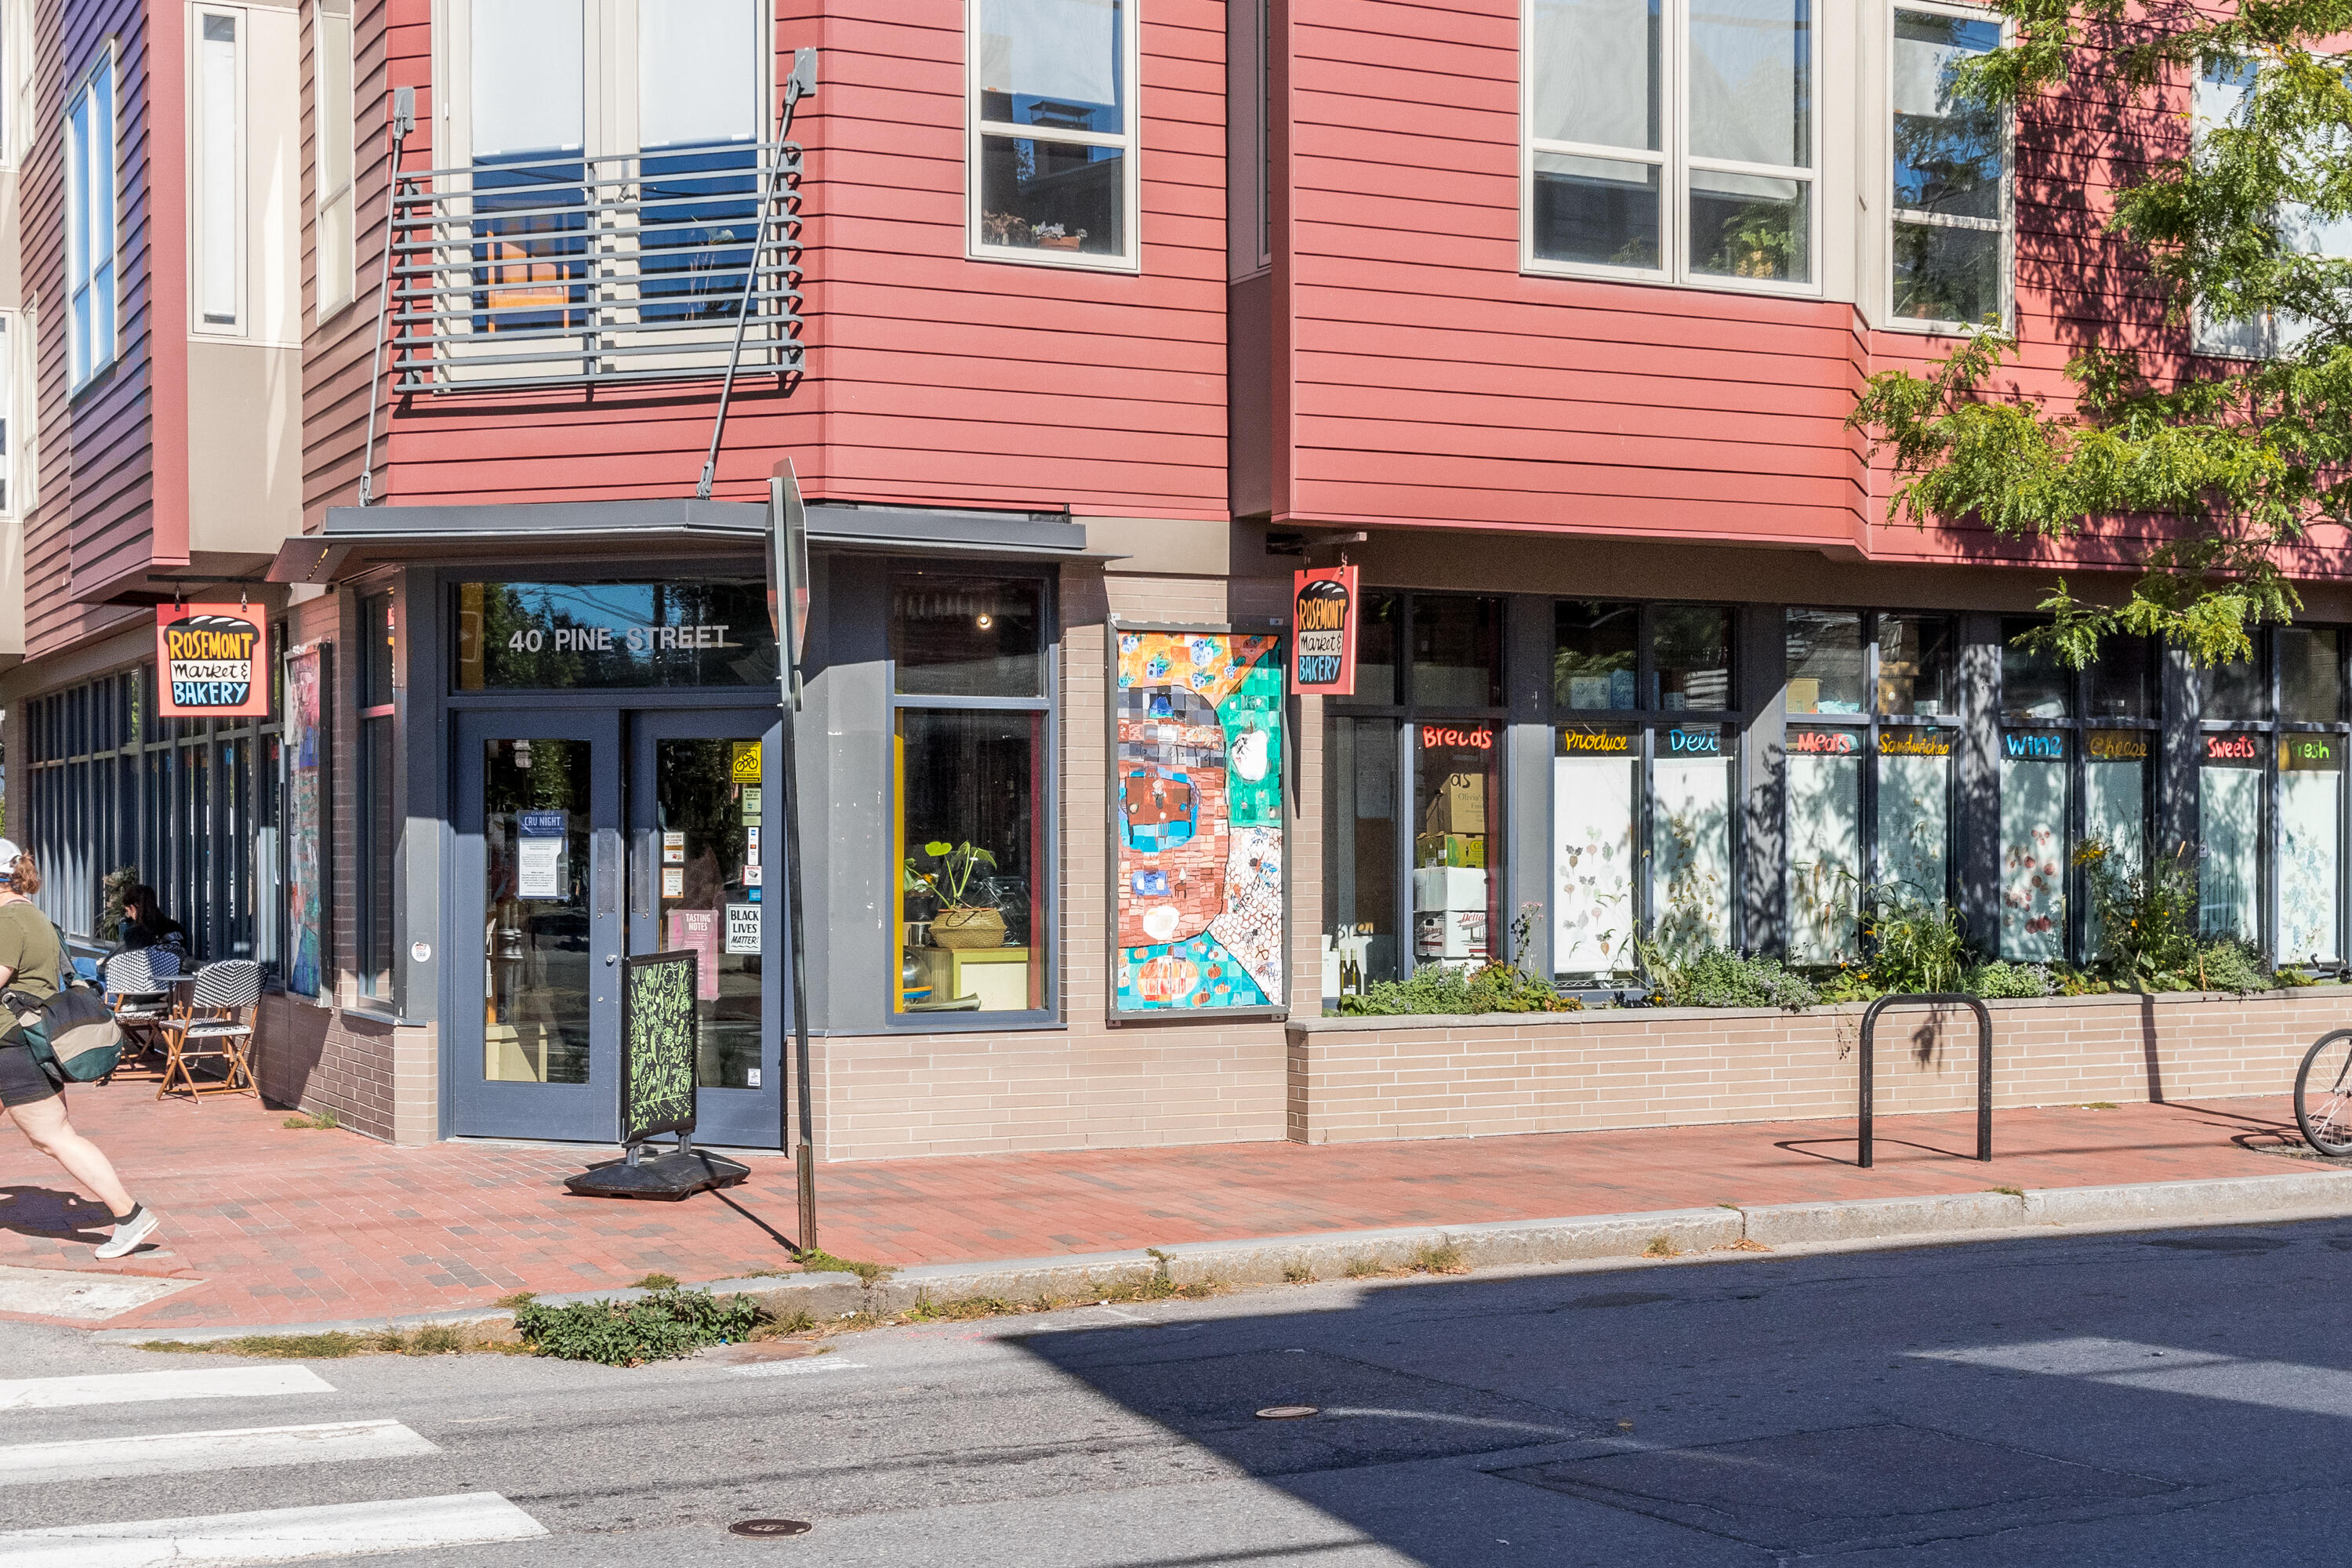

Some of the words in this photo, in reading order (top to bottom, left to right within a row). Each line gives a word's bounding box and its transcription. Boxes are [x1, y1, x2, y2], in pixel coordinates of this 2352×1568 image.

[1298, 597, 1346, 630] ROSEMONT
[169, 630, 253, 659] ROSEMONT
[508, 629, 543, 652] 40
[555, 627, 613, 652] PINE
[627, 625, 729, 652] STREET
[1300, 633, 1336, 652] Market
[172, 662, 239, 680] Market
[241, 662, 249, 680] &
[1299, 655, 1341, 682] BAKERY
[172, 682, 249, 705] BAKERY
[1565, 728, 1628, 752] Produce
[1668, 729, 1719, 752] Deli
[1880, 734, 1950, 755] Sandwiches
[2006, 735, 2063, 756] Wine
[2090, 737, 2148, 757] Cheese
[2207, 735, 2256, 758] Sweets
[524, 816, 538, 826] CRU
[539, 816, 561, 826] NIGHT
[686, 913, 711, 923] TASTING
[731, 909, 760, 921] BLACK
[688, 923, 708, 931] NOTES
[733, 924, 758, 934] LIVES
[731, 936, 760, 945] MATTER!
